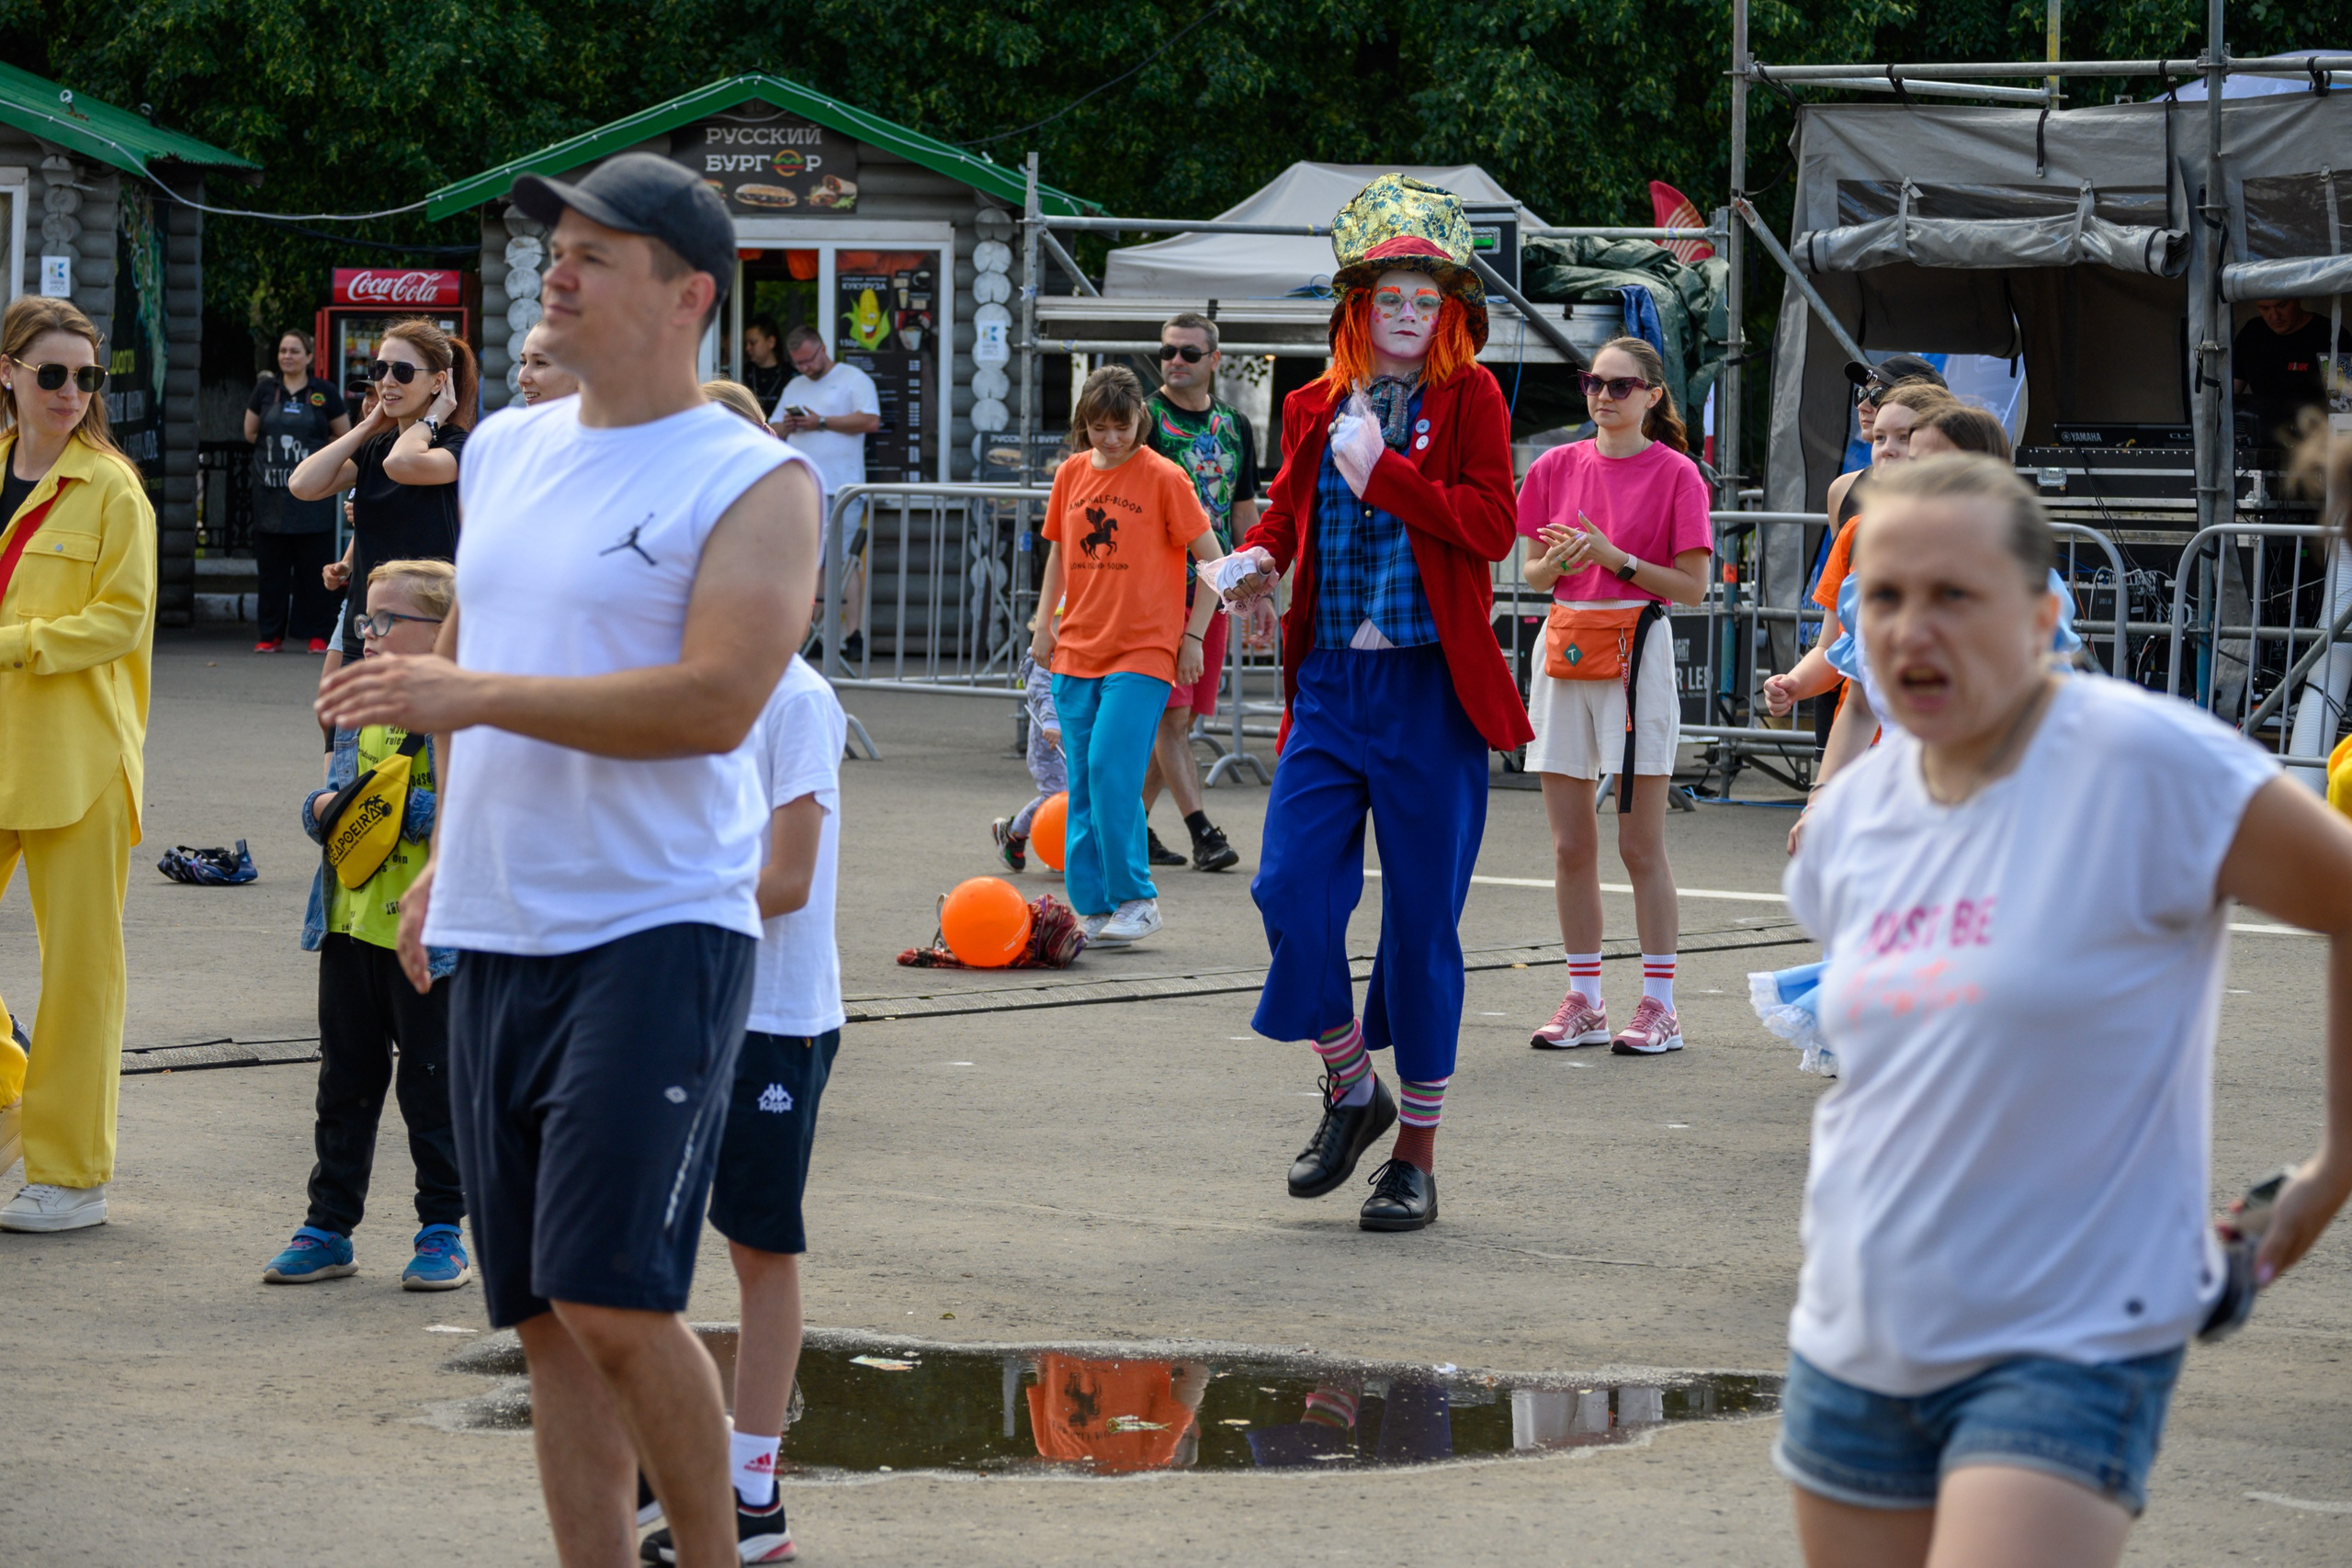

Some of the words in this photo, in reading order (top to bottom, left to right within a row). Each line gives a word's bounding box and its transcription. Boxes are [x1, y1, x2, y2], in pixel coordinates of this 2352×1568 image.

[706, 124, 822, 145] РУССКИЙ
[2071, 432, 2102, 442] YAMAHA
[265, 468, 294, 488] KITC
[1068, 499, 1086, 513] AMP
[1069, 561, 1086, 570] LONG
[1088, 561, 1105, 570] ISLND
[1107, 561, 1129, 570] SOUND
[1949, 897, 1997, 948] BE
[759, 1100, 792, 1113] Kappa
